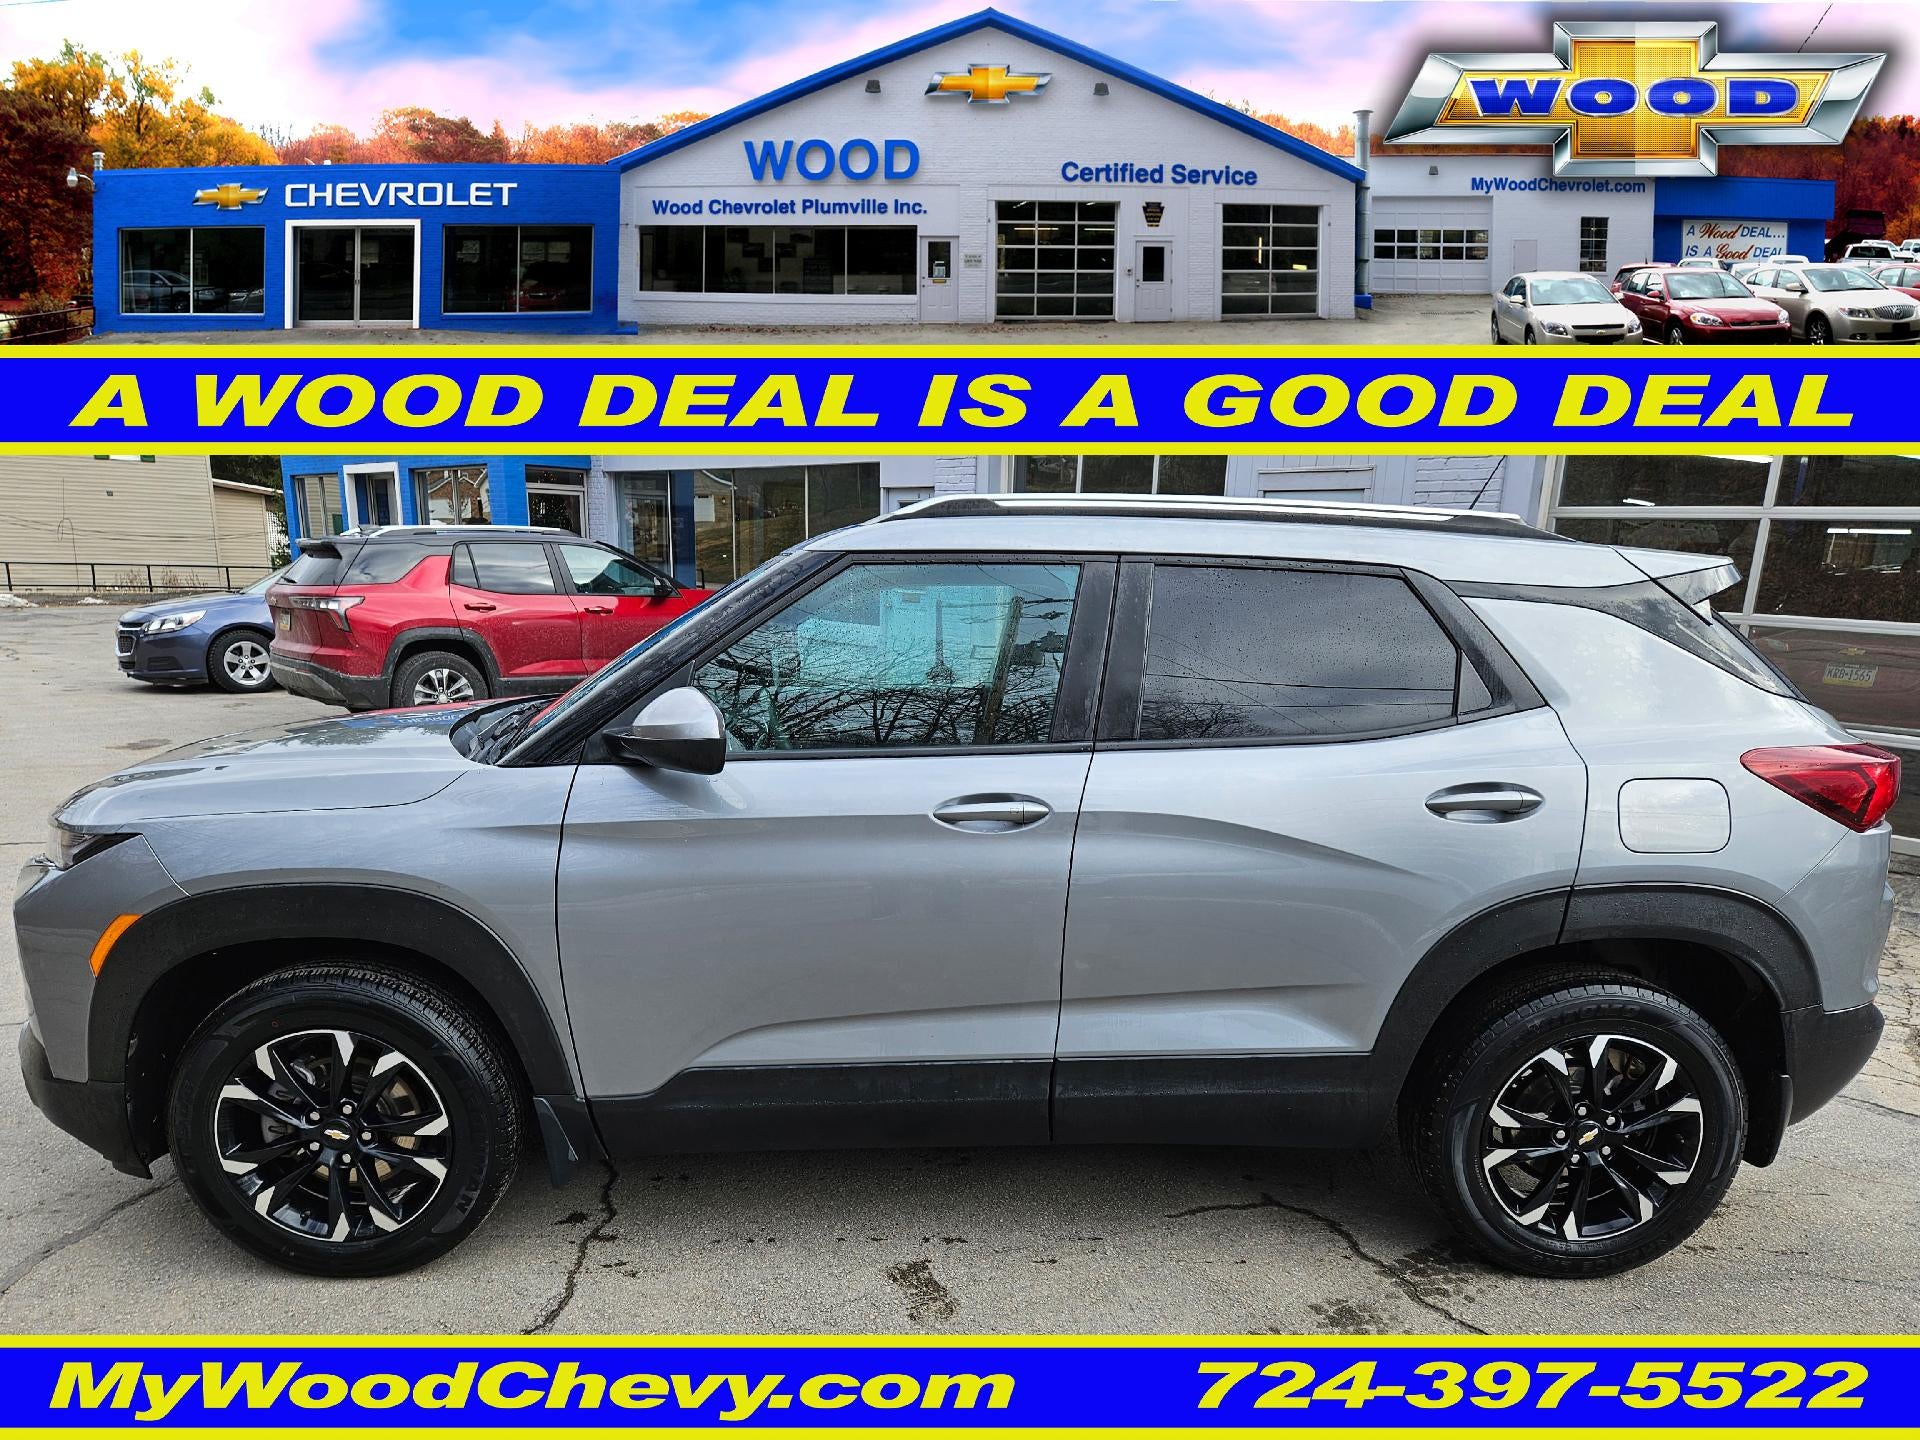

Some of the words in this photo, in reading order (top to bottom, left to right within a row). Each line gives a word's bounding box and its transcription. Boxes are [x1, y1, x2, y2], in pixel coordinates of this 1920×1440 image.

[743, 138, 920, 181] WOOD
[1061, 160, 1165, 184] Certified
[1170, 163, 1258, 186] Service
[284, 182, 518, 207] CHEVROLET
[1470, 176, 1646, 196] MyWoodChevrolet.com
[652, 199, 703, 216] Wood
[708, 198, 796, 216] Chevrolet
[801, 198, 889, 216] Plumville
[894, 198, 928, 216] Inc.
[1686, 224, 1696, 236] A
[1699, 222, 1743, 240] Wood
[1685, 245, 1699, 257] IS
[1703, 246, 1713, 257] A
[1715, 243, 1755, 260] Good
